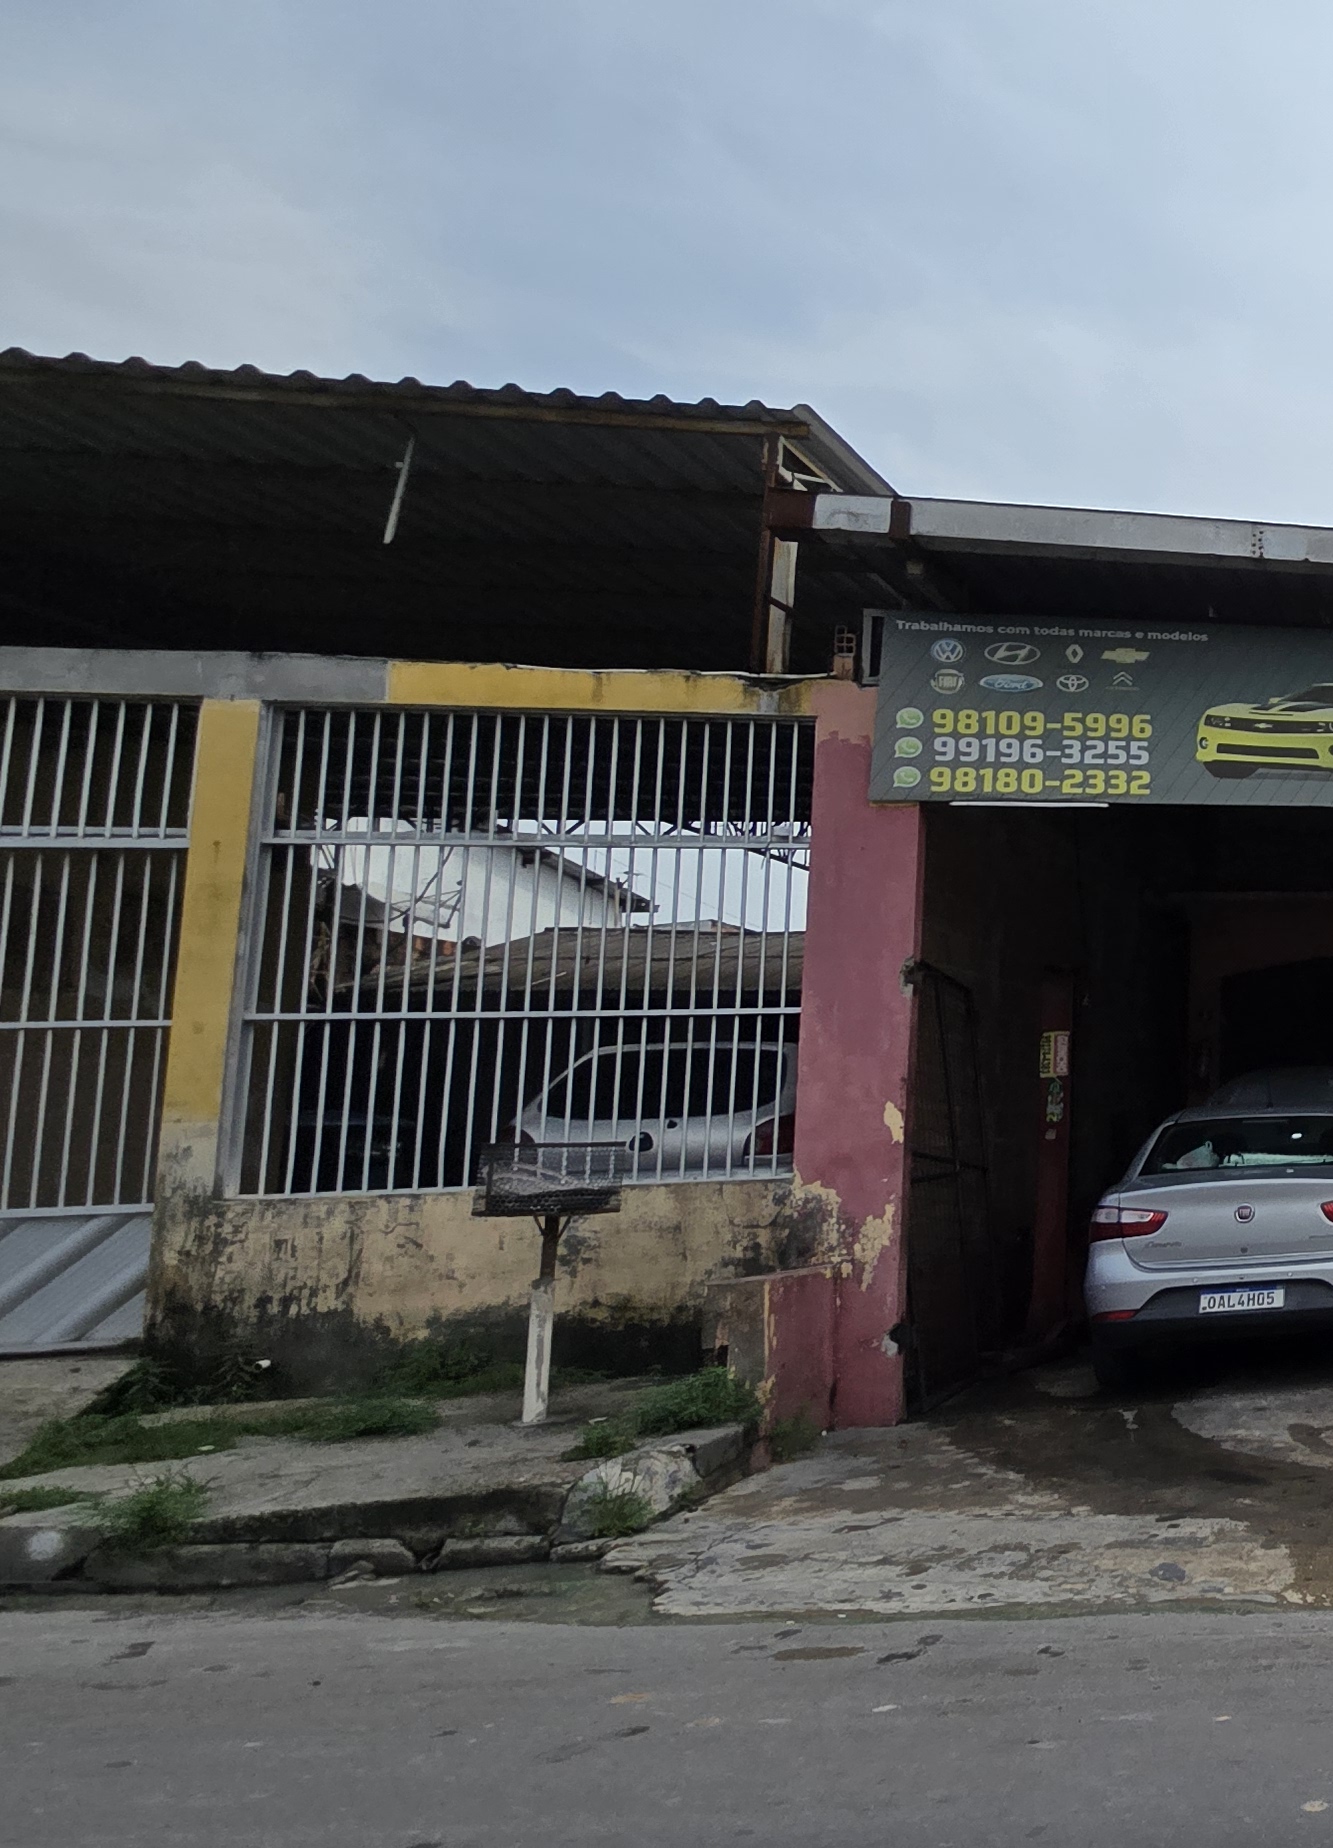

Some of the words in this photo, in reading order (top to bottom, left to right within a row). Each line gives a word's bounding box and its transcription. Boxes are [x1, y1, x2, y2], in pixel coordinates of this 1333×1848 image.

[896, 619, 993, 634] Trabalhamos
[997, 624, 1030, 636] com
[1034, 626, 1075, 637] todas
[1079, 628, 1131, 639] marcas
[1135, 631, 1144, 640] e
[1147, 631, 1208, 642] modelos
[932, 708, 1153, 738] 98109-5996
[933, 736, 1150, 765] 99196-3255
[929, 766, 1151, 795] 98180-2332
[1207, 1291, 1275, 1310] OAL4H05
